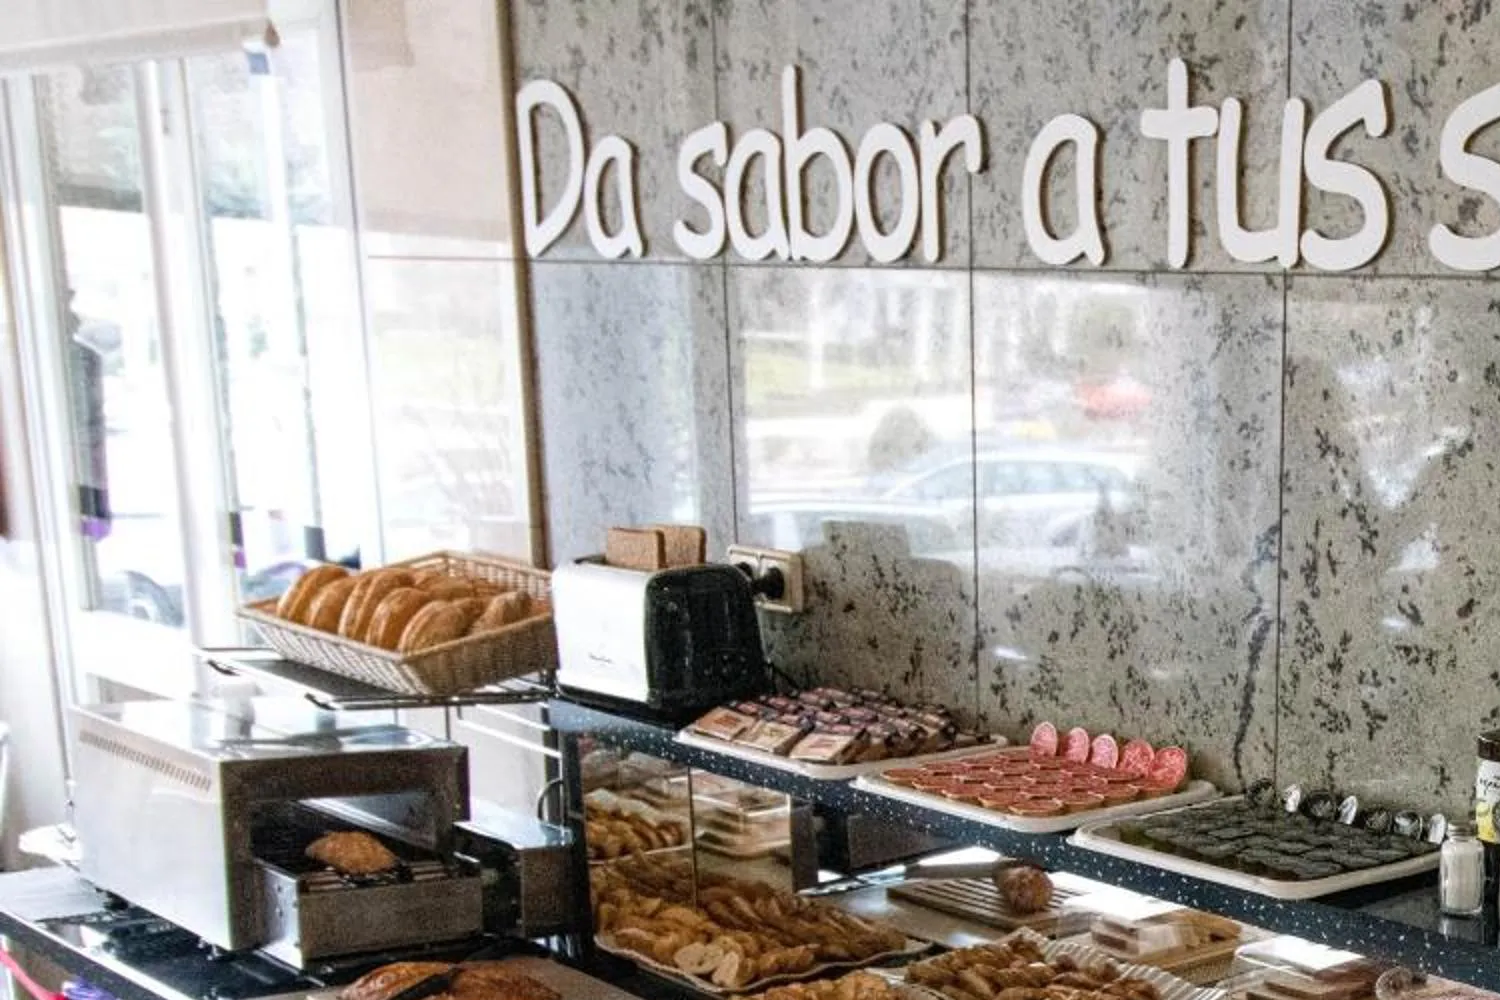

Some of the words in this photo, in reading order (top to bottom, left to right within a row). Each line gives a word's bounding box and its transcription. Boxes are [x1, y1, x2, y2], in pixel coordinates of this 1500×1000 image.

[517, 78, 644, 259] Da
[673, 64, 982, 263] sabor
[1022, 114, 1106, 266] a
[1140, 57, 1391, 271] tus
